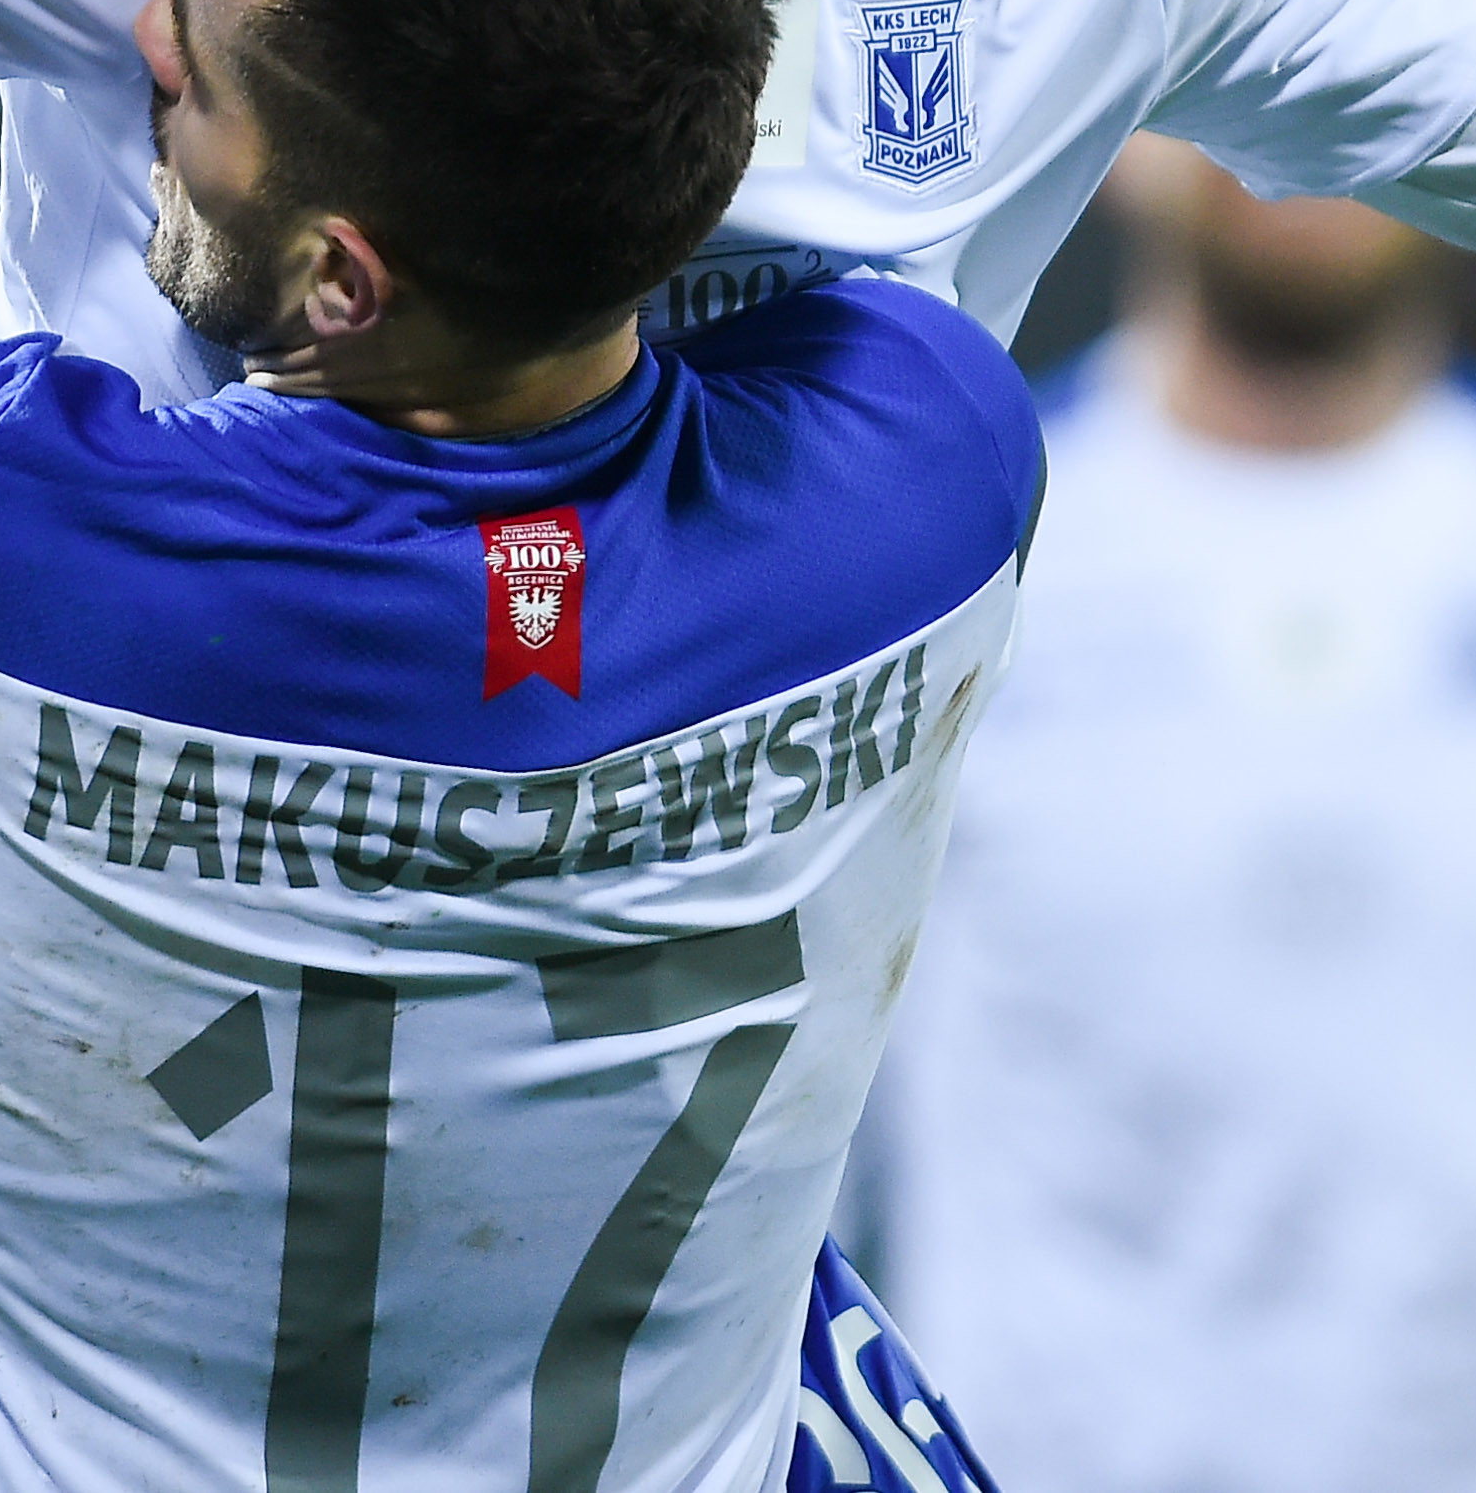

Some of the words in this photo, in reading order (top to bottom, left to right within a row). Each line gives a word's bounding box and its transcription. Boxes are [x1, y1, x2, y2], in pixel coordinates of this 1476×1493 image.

[873, 13, 905, 31] KKS
[910, 7, 952, 28] LECH
[896, 35, 928, 50] 1922
[880, 134, 953, 170] POZNAŃ
[667, 262, 790, 329] 100
[508, 544, 562, 569] 100
[507, 575, 564, 586] ROCZNICA
[23, 640, 927, 893] MAKUSZEWSKI
[145, 906, 806, 1493] 17
